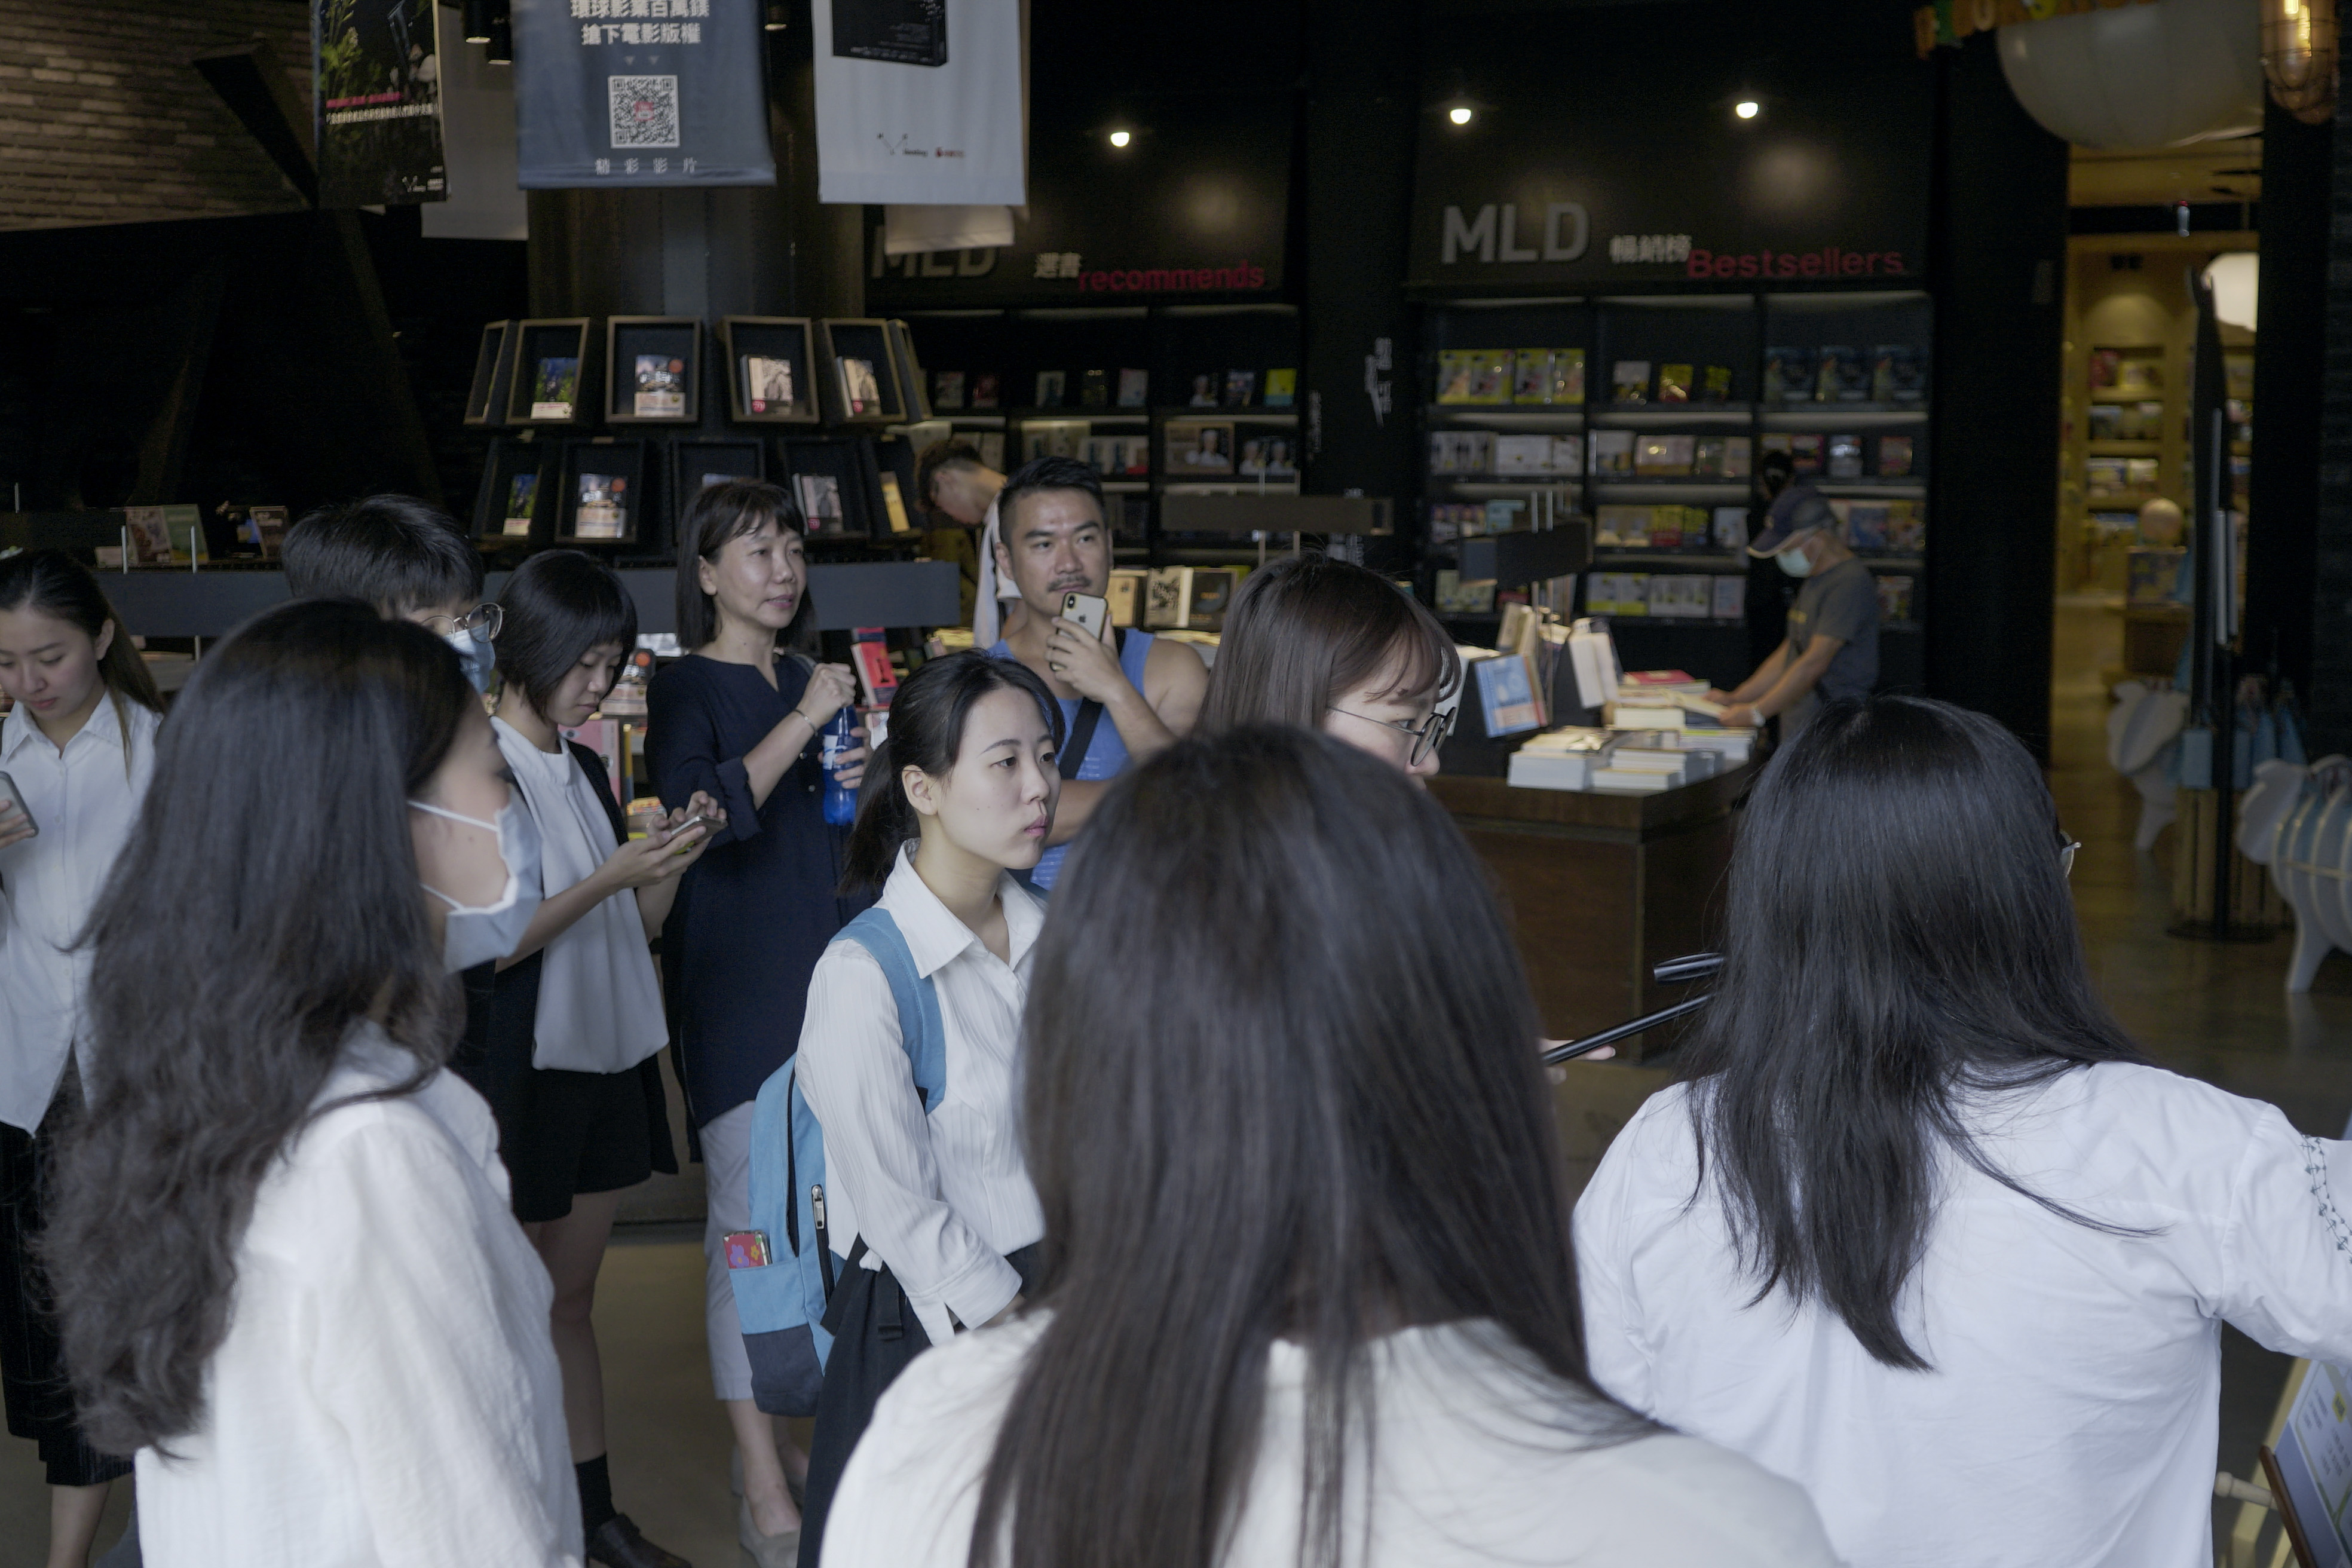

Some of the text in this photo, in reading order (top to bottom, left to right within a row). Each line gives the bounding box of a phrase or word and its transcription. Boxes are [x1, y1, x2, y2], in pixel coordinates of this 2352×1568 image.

[581, 23, 702, 45] 搶下電影版權
[595, 157, 697, 175] 精彩影片
[1442, 203, 1589, 264] MLD
[1609, 234, 1692, 264] 暢銷榜
[1079, 261, 1265, 293] recommends
[1686, 247, 1904, 279] Bestsellers
